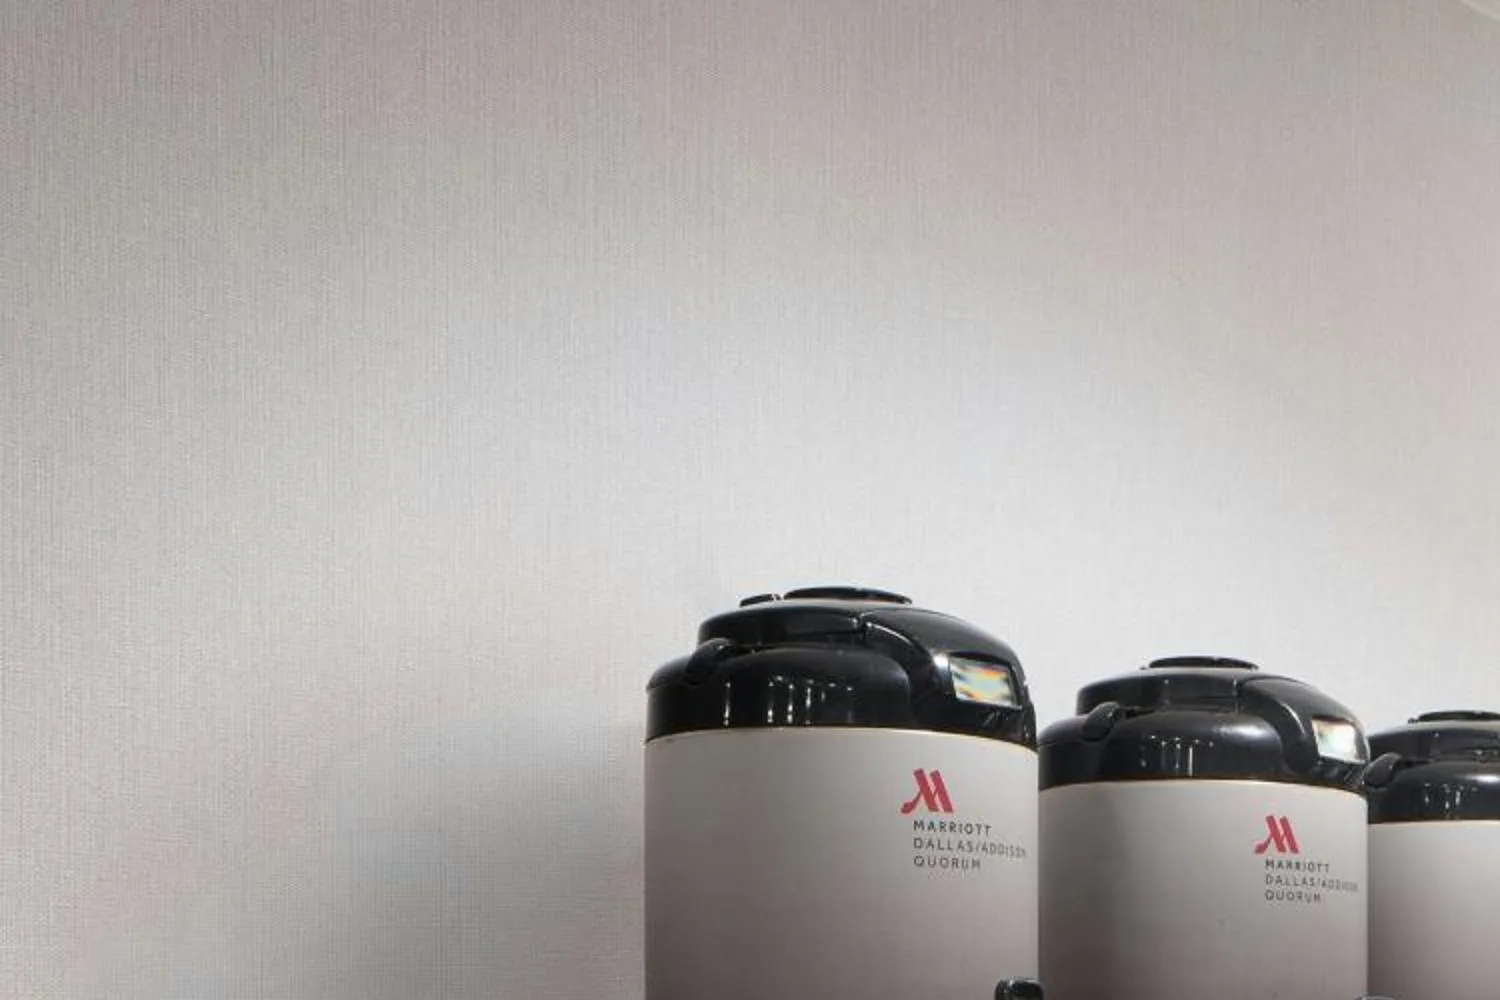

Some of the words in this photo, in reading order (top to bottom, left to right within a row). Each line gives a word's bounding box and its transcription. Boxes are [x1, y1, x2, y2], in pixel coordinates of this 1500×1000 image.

[913, 820, 992, 836] MARRIOTT
[913, 855, 982, 869] QUORUM
[1265, 859, 1330, 873] MARRIOTT
[1265, 874, 1360, 892] DALLAS/ADD
